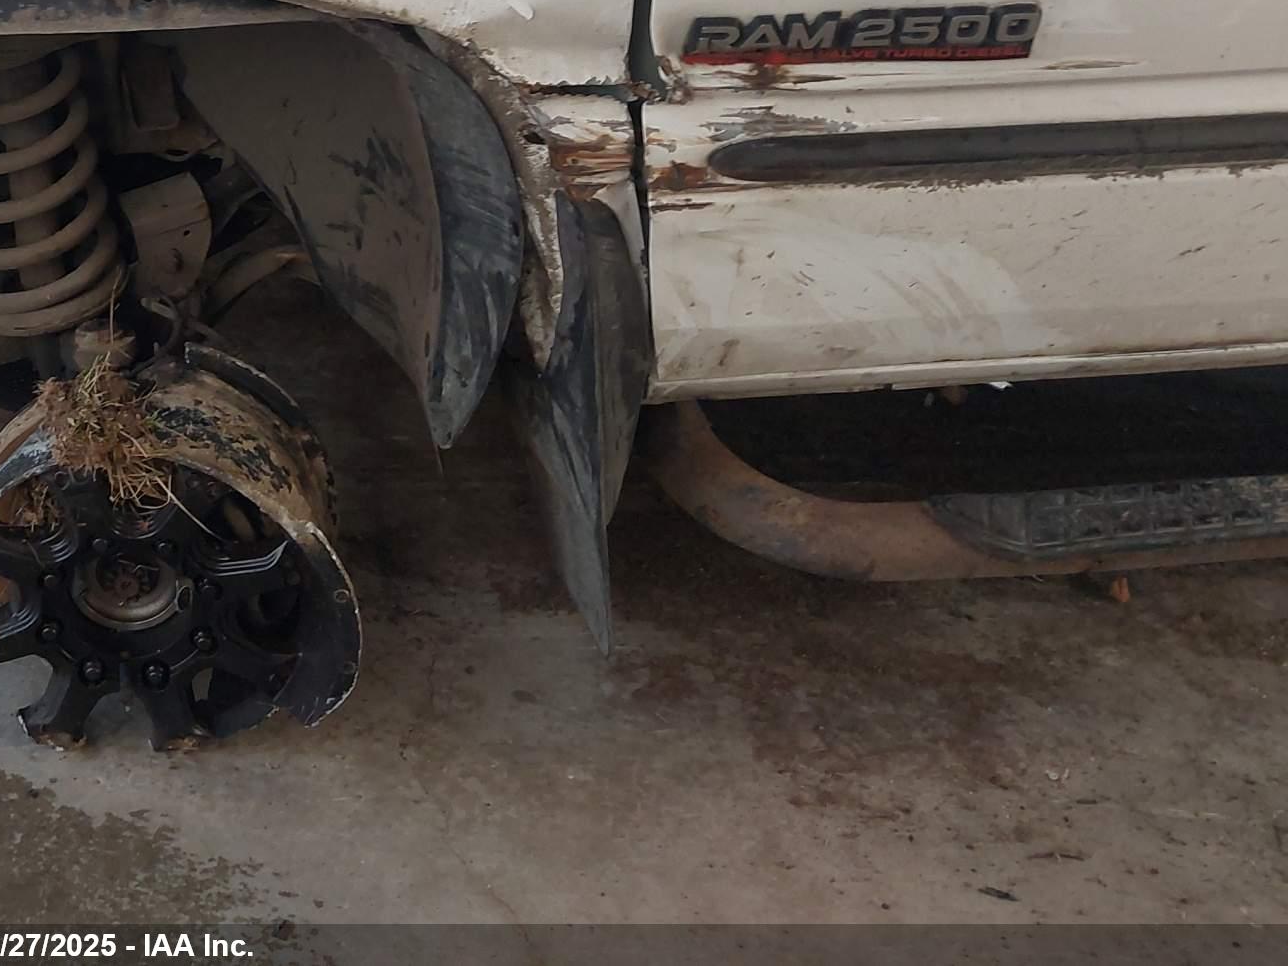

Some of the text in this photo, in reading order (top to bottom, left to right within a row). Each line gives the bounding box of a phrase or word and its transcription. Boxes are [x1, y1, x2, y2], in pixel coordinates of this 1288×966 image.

[689, 3, 1042, 51] RAM 2500
[885, 47, 951, 59] TURBO
[955, 44, 1027, 58] DIESEL
